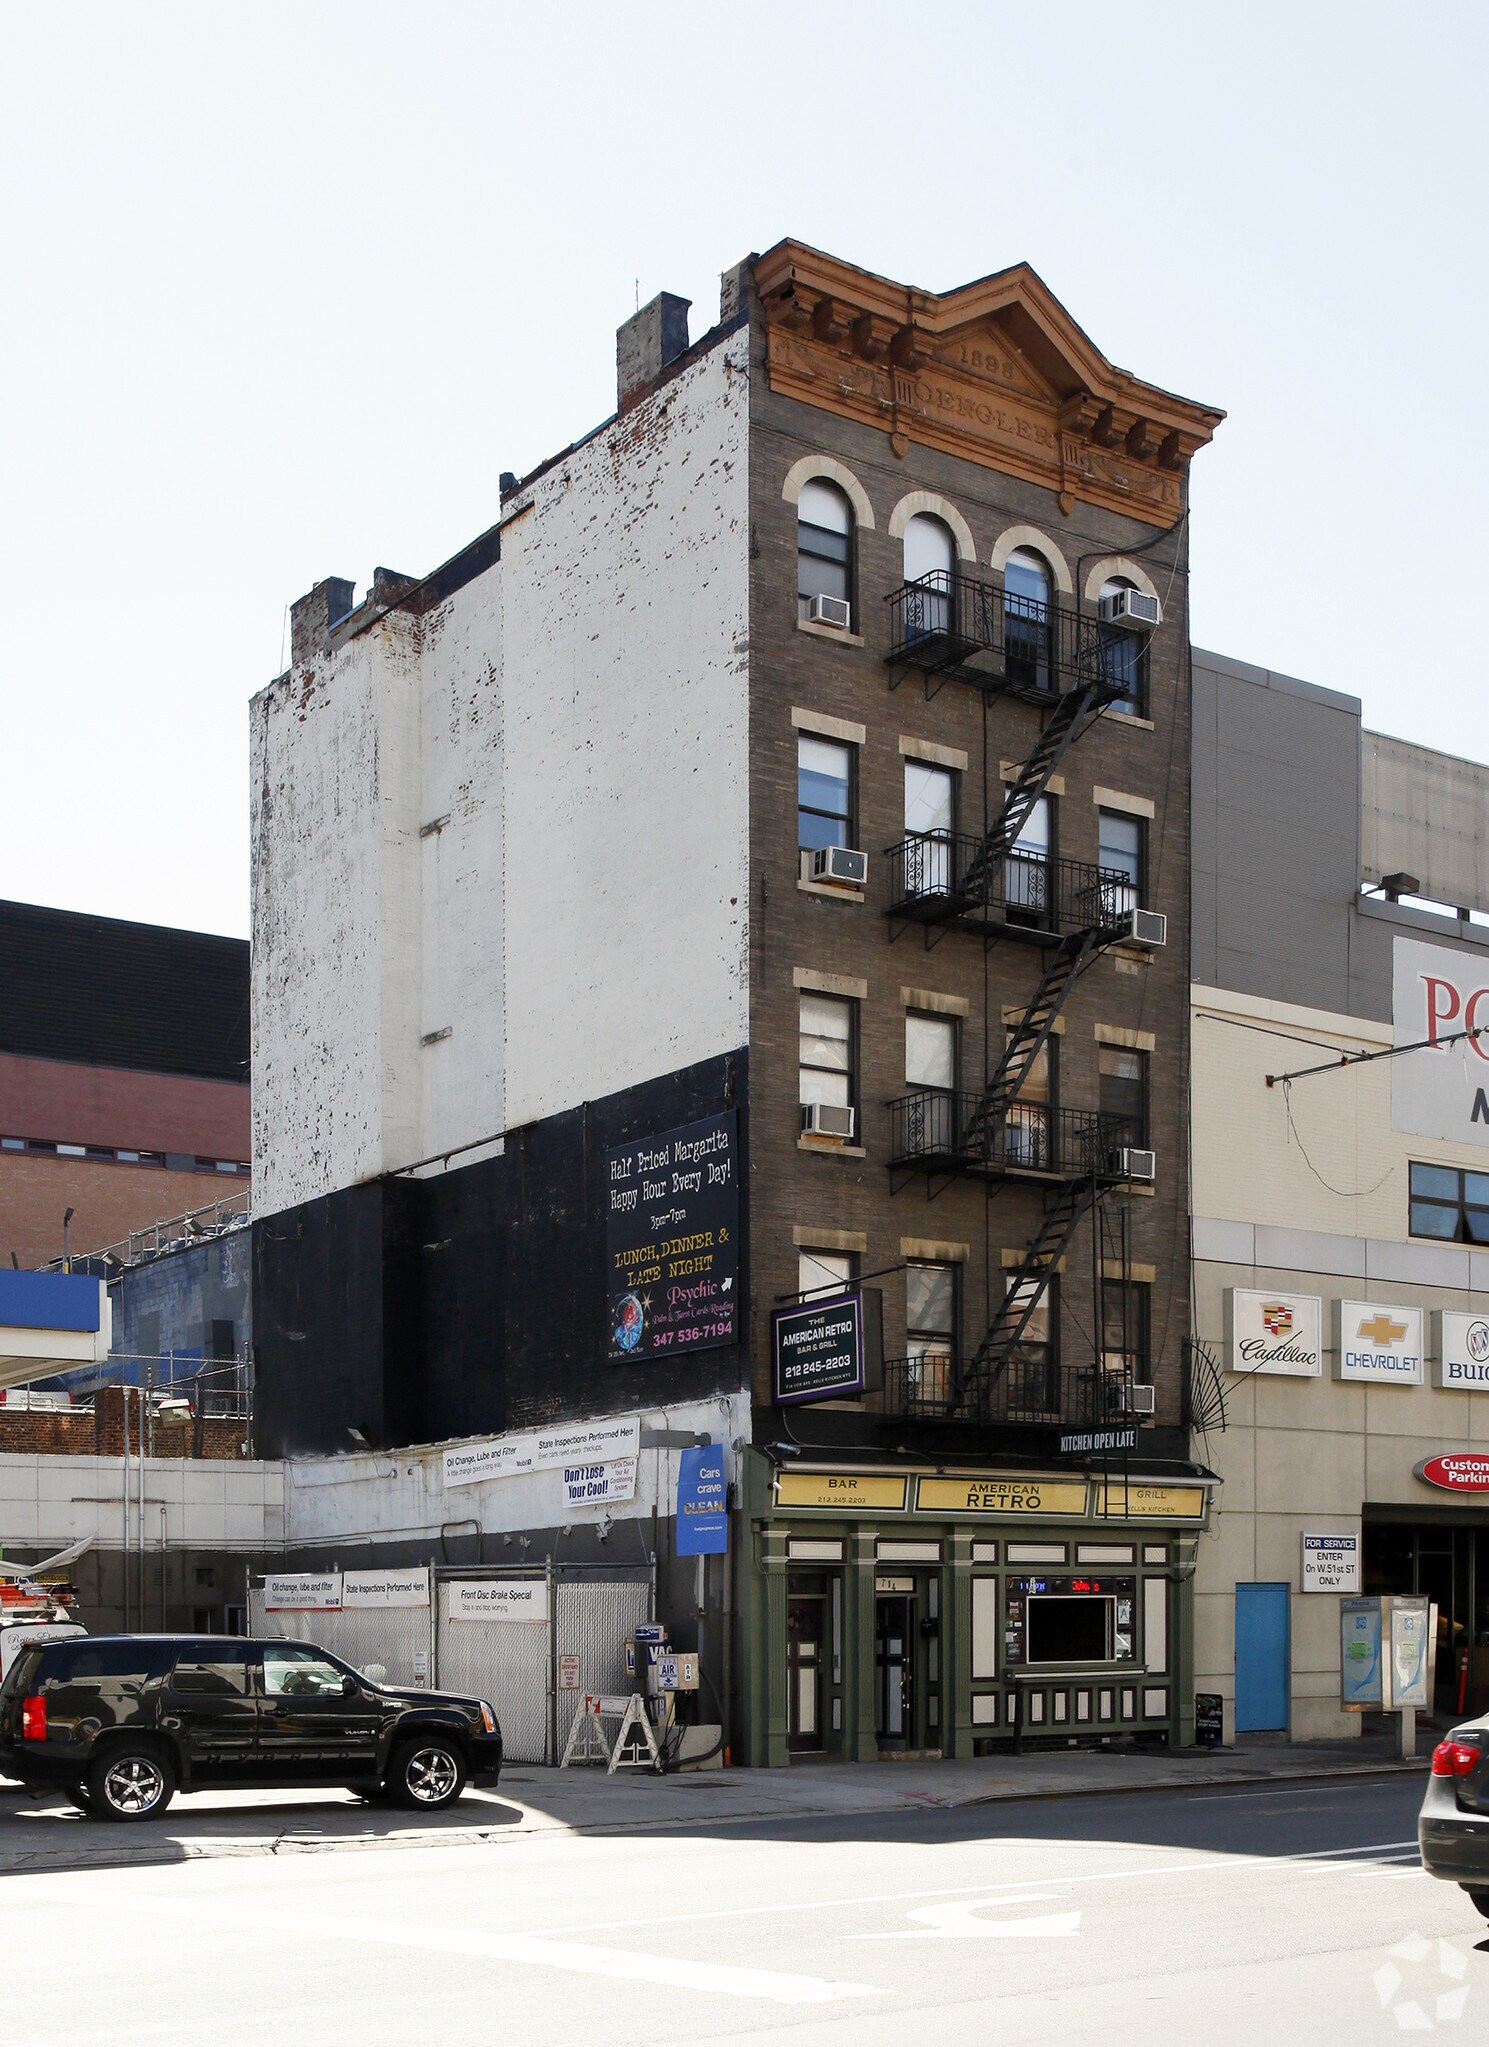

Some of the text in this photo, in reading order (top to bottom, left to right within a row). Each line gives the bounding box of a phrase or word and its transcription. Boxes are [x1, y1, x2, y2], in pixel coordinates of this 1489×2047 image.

[611, 1130, 728, 1180] Half Priced Margarita
[611, 1158, 731, 1211] Happy Hour Every Day!
[718, 1227, 730, 1243] &
[627, 1254, 713, 1287] LATE NIGHT
[667, 1279, 718, 1311] Psychic
[808, 1317, 825, 1326] THE
[653, 1321, 732, 1347] 347 536-7194
[783, 1320, 852, 1347] AMERICAN RETRO
[796, 1340, 838, 1355] BAR & GRILL
[1239, 1338, 1317, 1365] Cadillac
[1346, 1352, 1418, 1373] CHEVROLET
[785, 1354, 851, 1379] 212 245-2203
[538, 1428, 634, 1450] State Inspections Performed Here
[1060, 1430, 1135, 1452] KITCHEN OPEN LATE
[455, 1455, 476, 1466] Change,
[477, 1452, 490, 1461] Lube
[491, 1448, 501, 1459] and
[502, 1446, 517, 1456] Filter
[564, 1465, 605, 1483] Don't Lose
[699, 1467, 720, 1479] Cars
[568, 1484, 586, 1499] Your
[587, 1479, 609, 1497] Cool!
[697, 1483, 722, 1494] crave
[828, 1479, 858, 1489] BAR
[970, 1484, 1040, 1494] AMERICAN
[818, 1496, 866, 1504] 212.245.2203
[967, 1494, 1041, 1509] RETRO
[1137, 1490, 1167, 1499] GRILL
[683, 1500, 725, 1515] CLEAN.
[1306, 1539, 1355, 1549] FOR SERVICE
[1317, 1552, 1343, 1560] ENTER
[1306, 1564, 1315, 1573] On
[1346, 1565, 1355, 1573] ST
[299, 1582, 310, 1591] lube
[311, 1582, 321, 1591] and
[1319, 1576, 1341, 1585] ONLY
[346, 1583, 424, 1594] State Inspections Performed Here
[461, 1590, 532, 1601] Front Disc Brake Special
[1120, 1608, 1127, 1618] A
[662, 1665, 674, 1674] AIR
